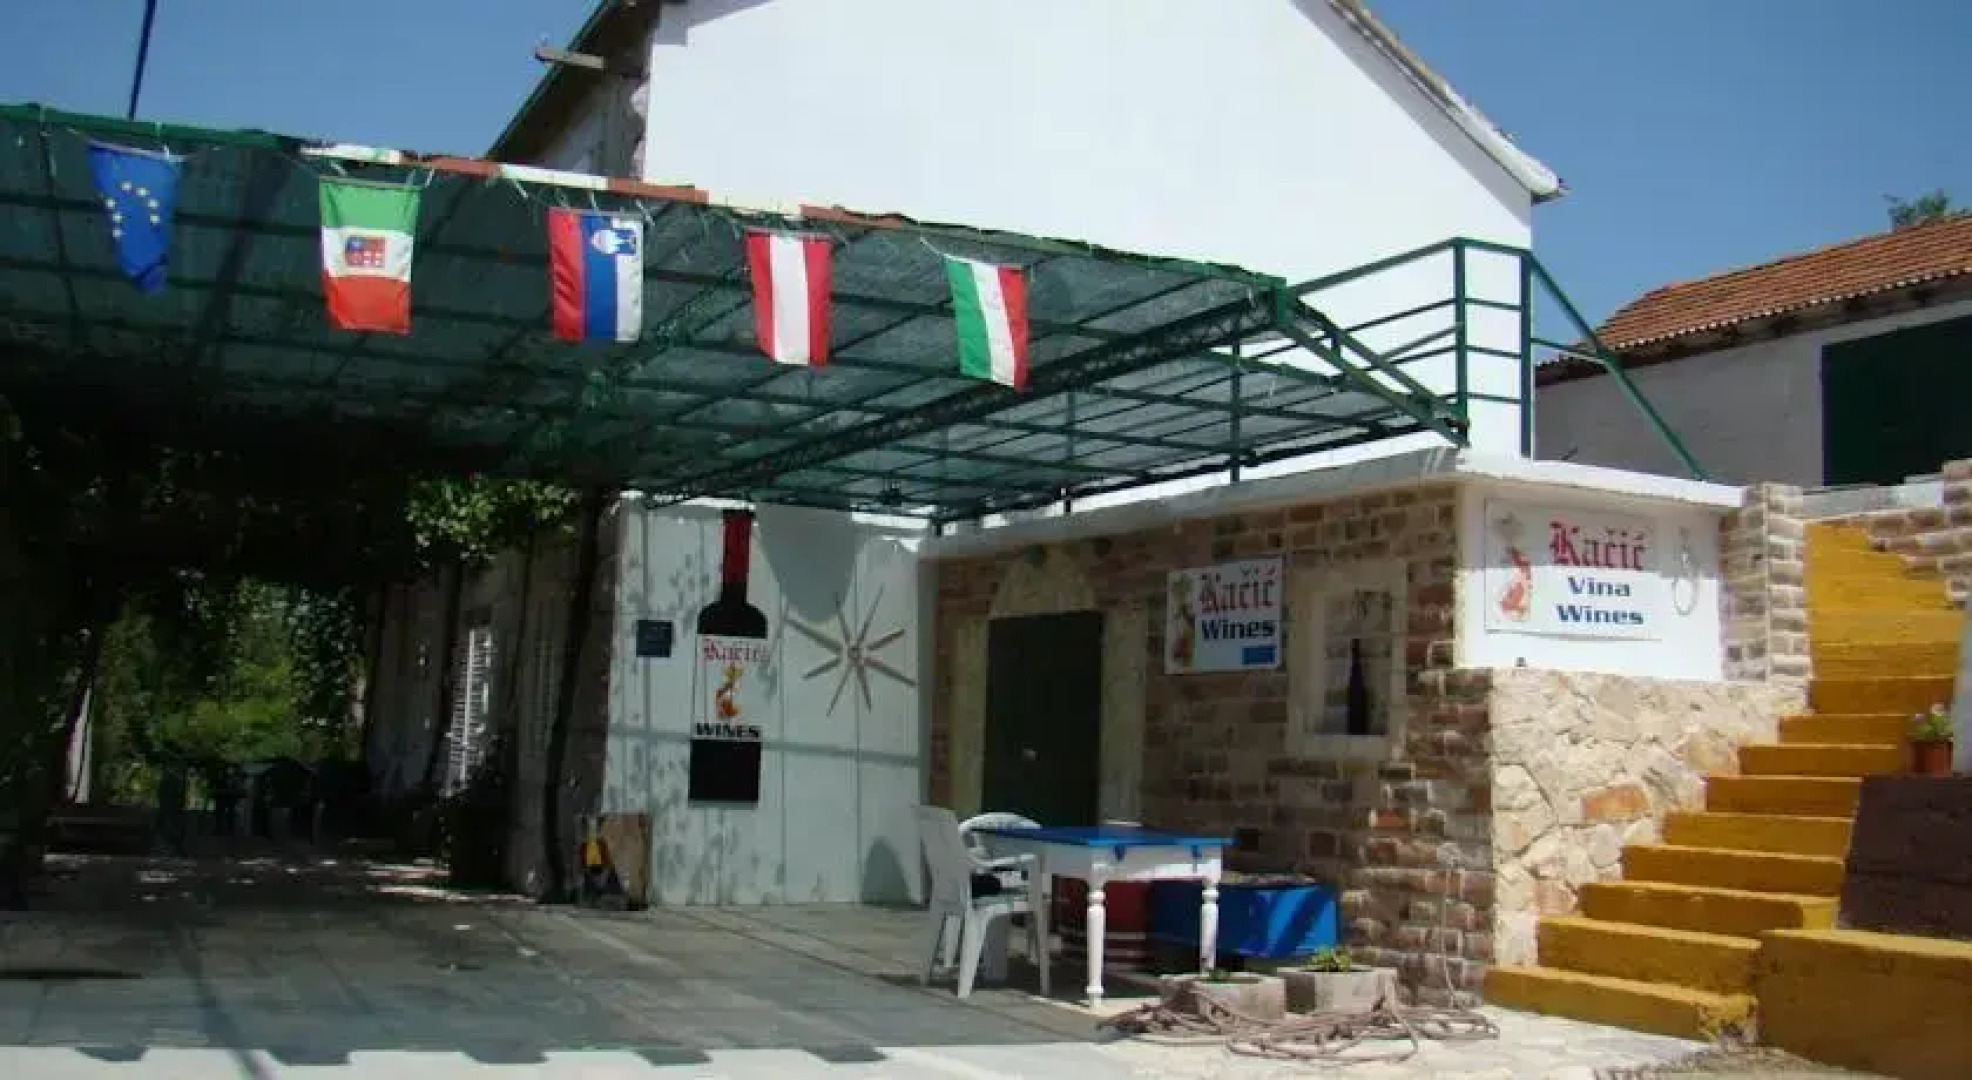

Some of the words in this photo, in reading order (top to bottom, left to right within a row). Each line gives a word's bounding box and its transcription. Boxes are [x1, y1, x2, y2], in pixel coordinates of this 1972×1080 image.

[1549, 520, 1645, 571] Kačić
[1567, 577, 1630, 597] Vina
[1556, 605, 1644, 625] Wines
[1201, 619, 1275, 640] Wines
[695, 722, 760, 738] WINES
